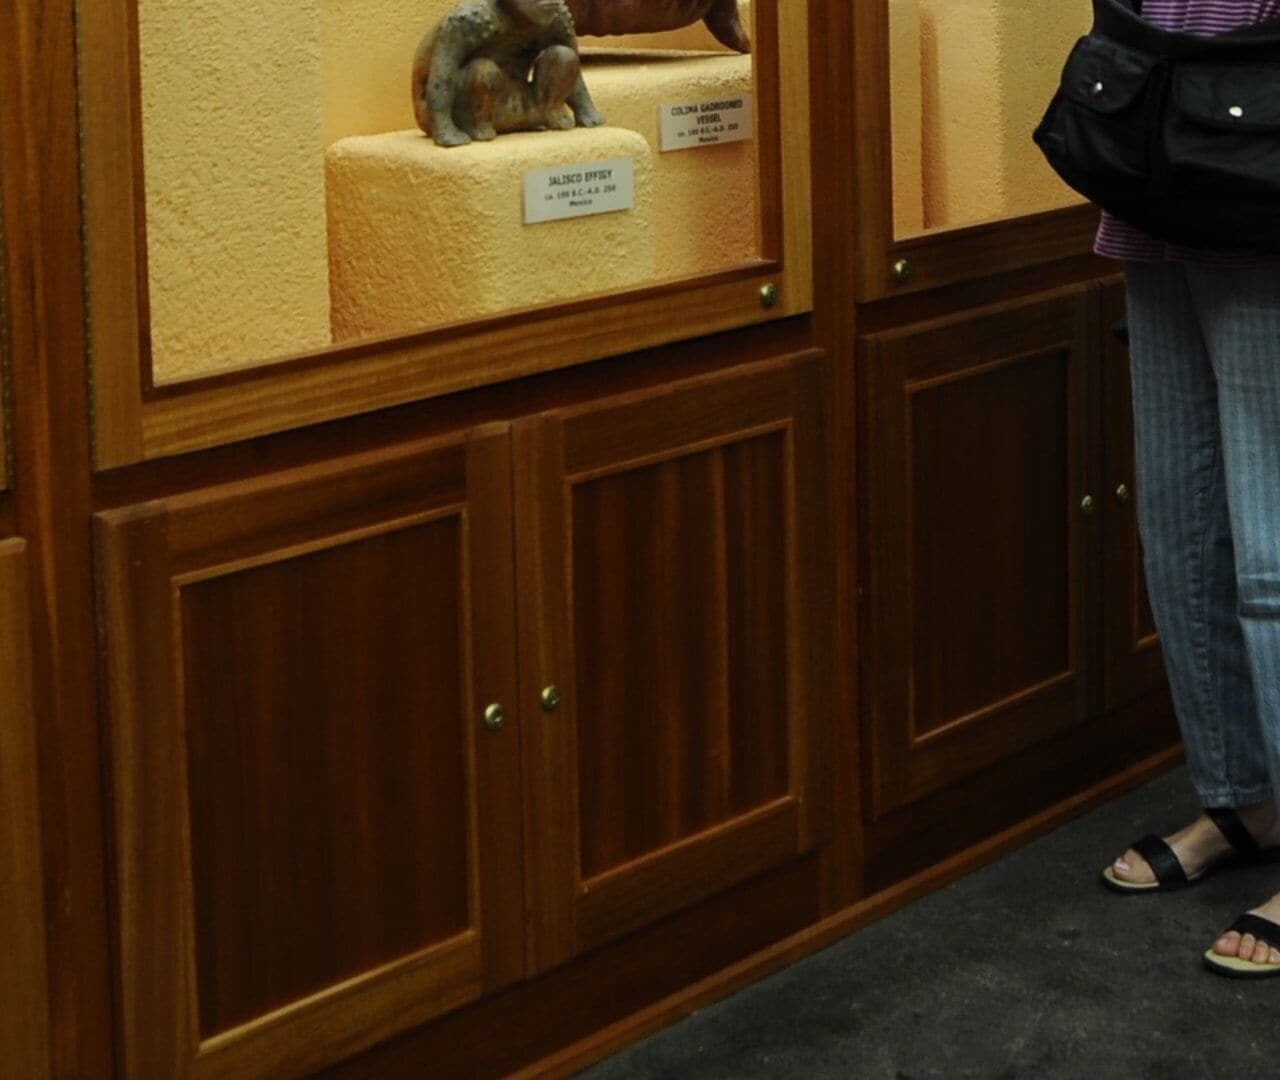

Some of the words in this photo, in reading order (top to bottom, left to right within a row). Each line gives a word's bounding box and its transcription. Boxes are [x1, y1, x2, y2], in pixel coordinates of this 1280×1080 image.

[671, 105, 699, 117] COLIMA
[696, 112, 722, 125] VESSEL
[548, 174, 582, 187] JALISCO
[584, 169, 613, 182] EFFIGY
